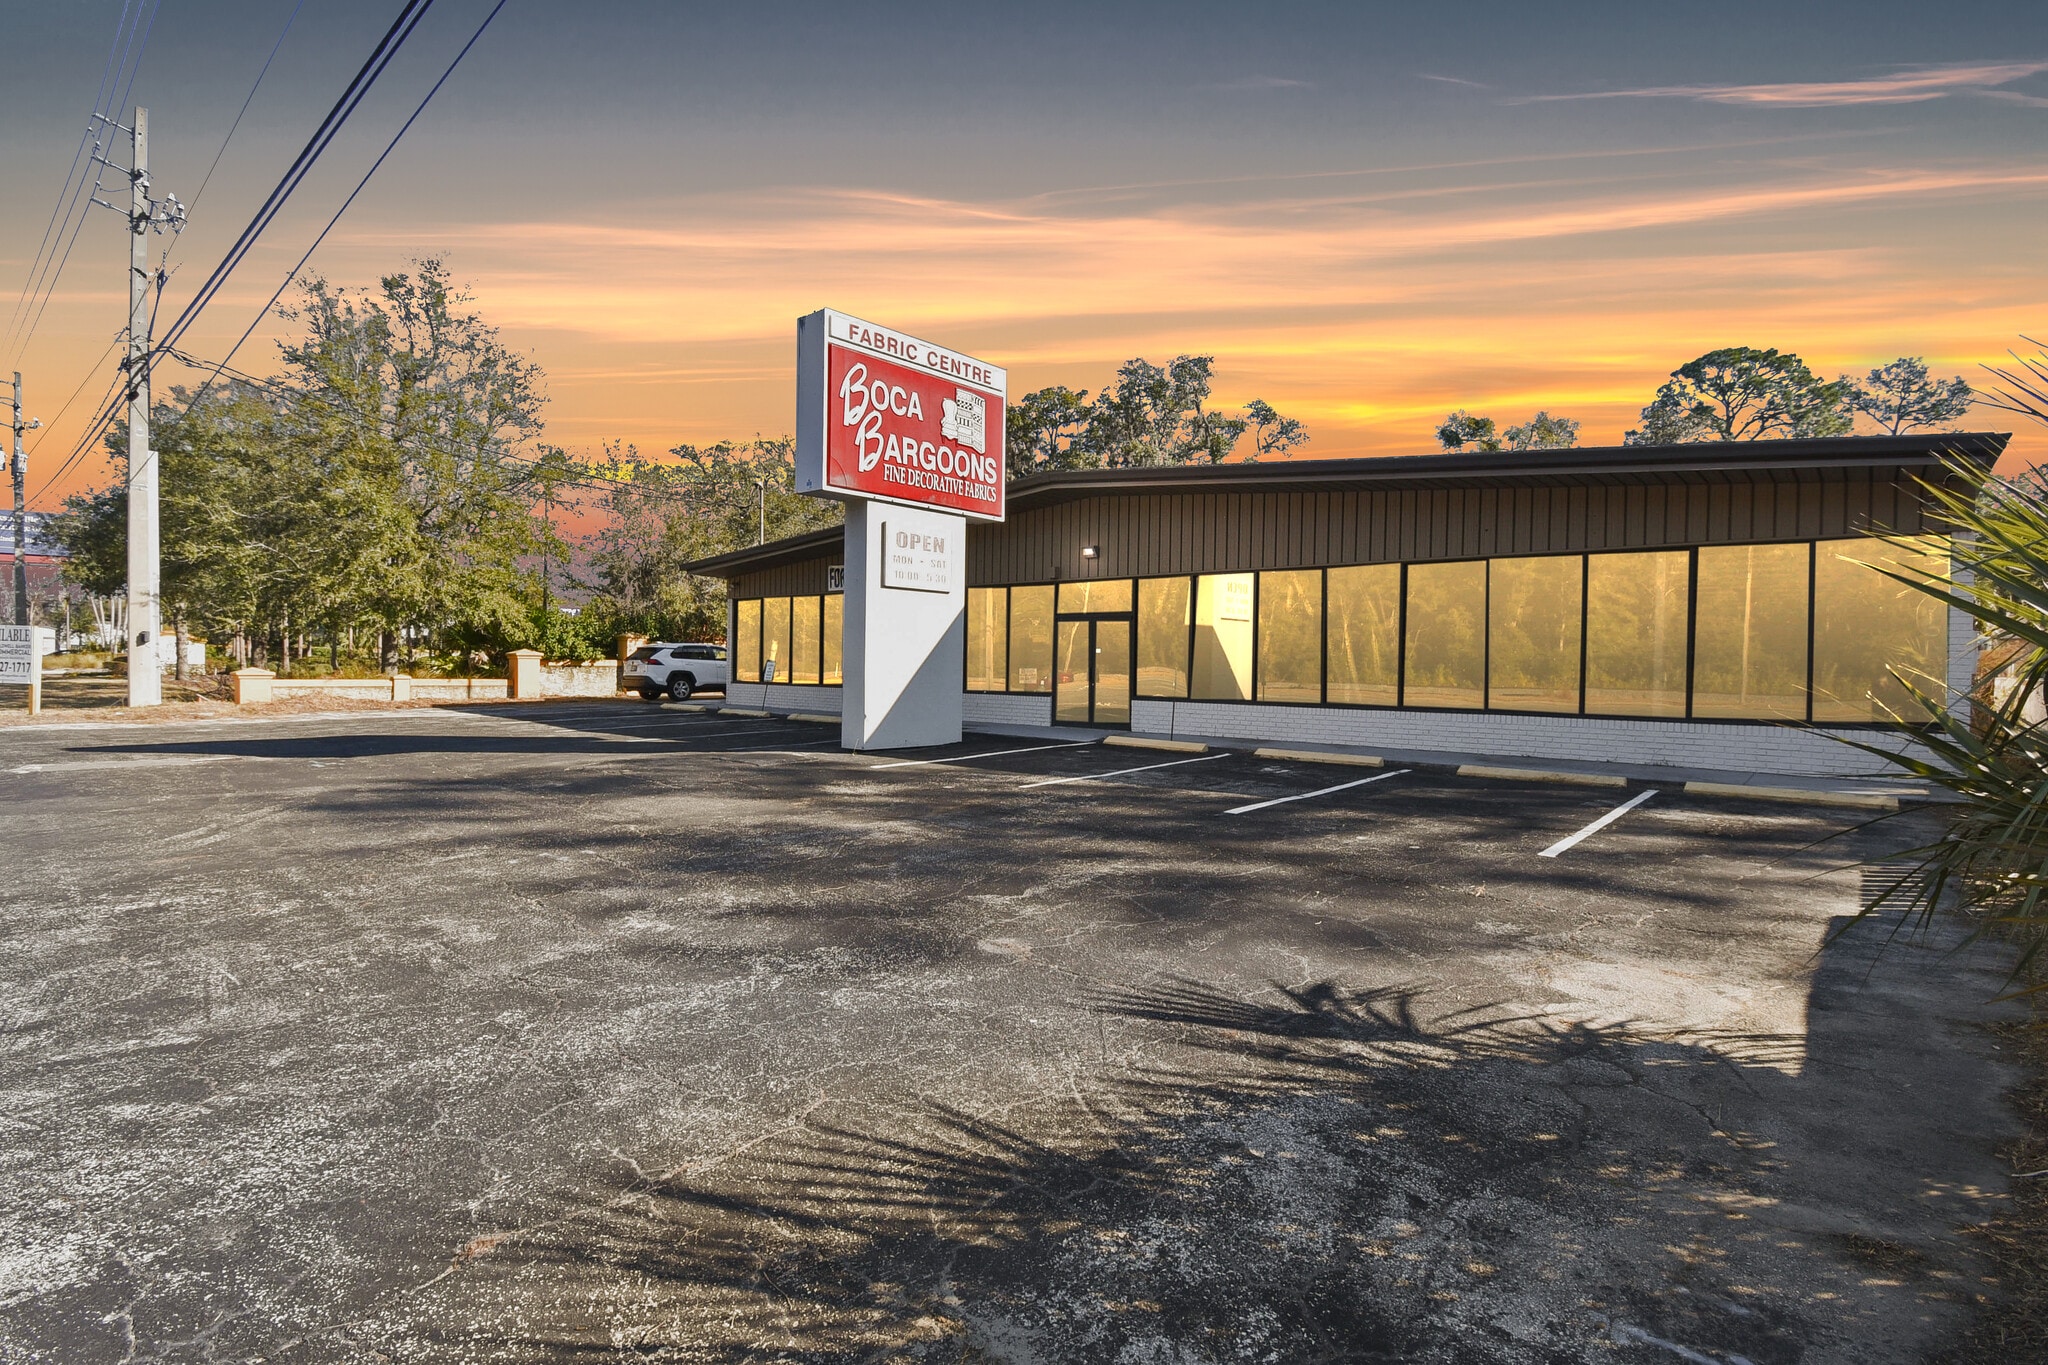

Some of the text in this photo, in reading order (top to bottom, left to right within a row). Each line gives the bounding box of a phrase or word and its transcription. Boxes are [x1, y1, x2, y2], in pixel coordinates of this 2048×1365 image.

[849, 323, 992, 385] FABRIC CENTRE
[840, 362, 923, 426] BOCA
[855, 411, 997, 484] BARGOONS
[883, 463, 997, 502] FINE DECORATIVE FABRICS
[893, 555, 913, 564] MON
[930, 559, 946, 569] SAT
[896, 531, 945, 554] OPEN
